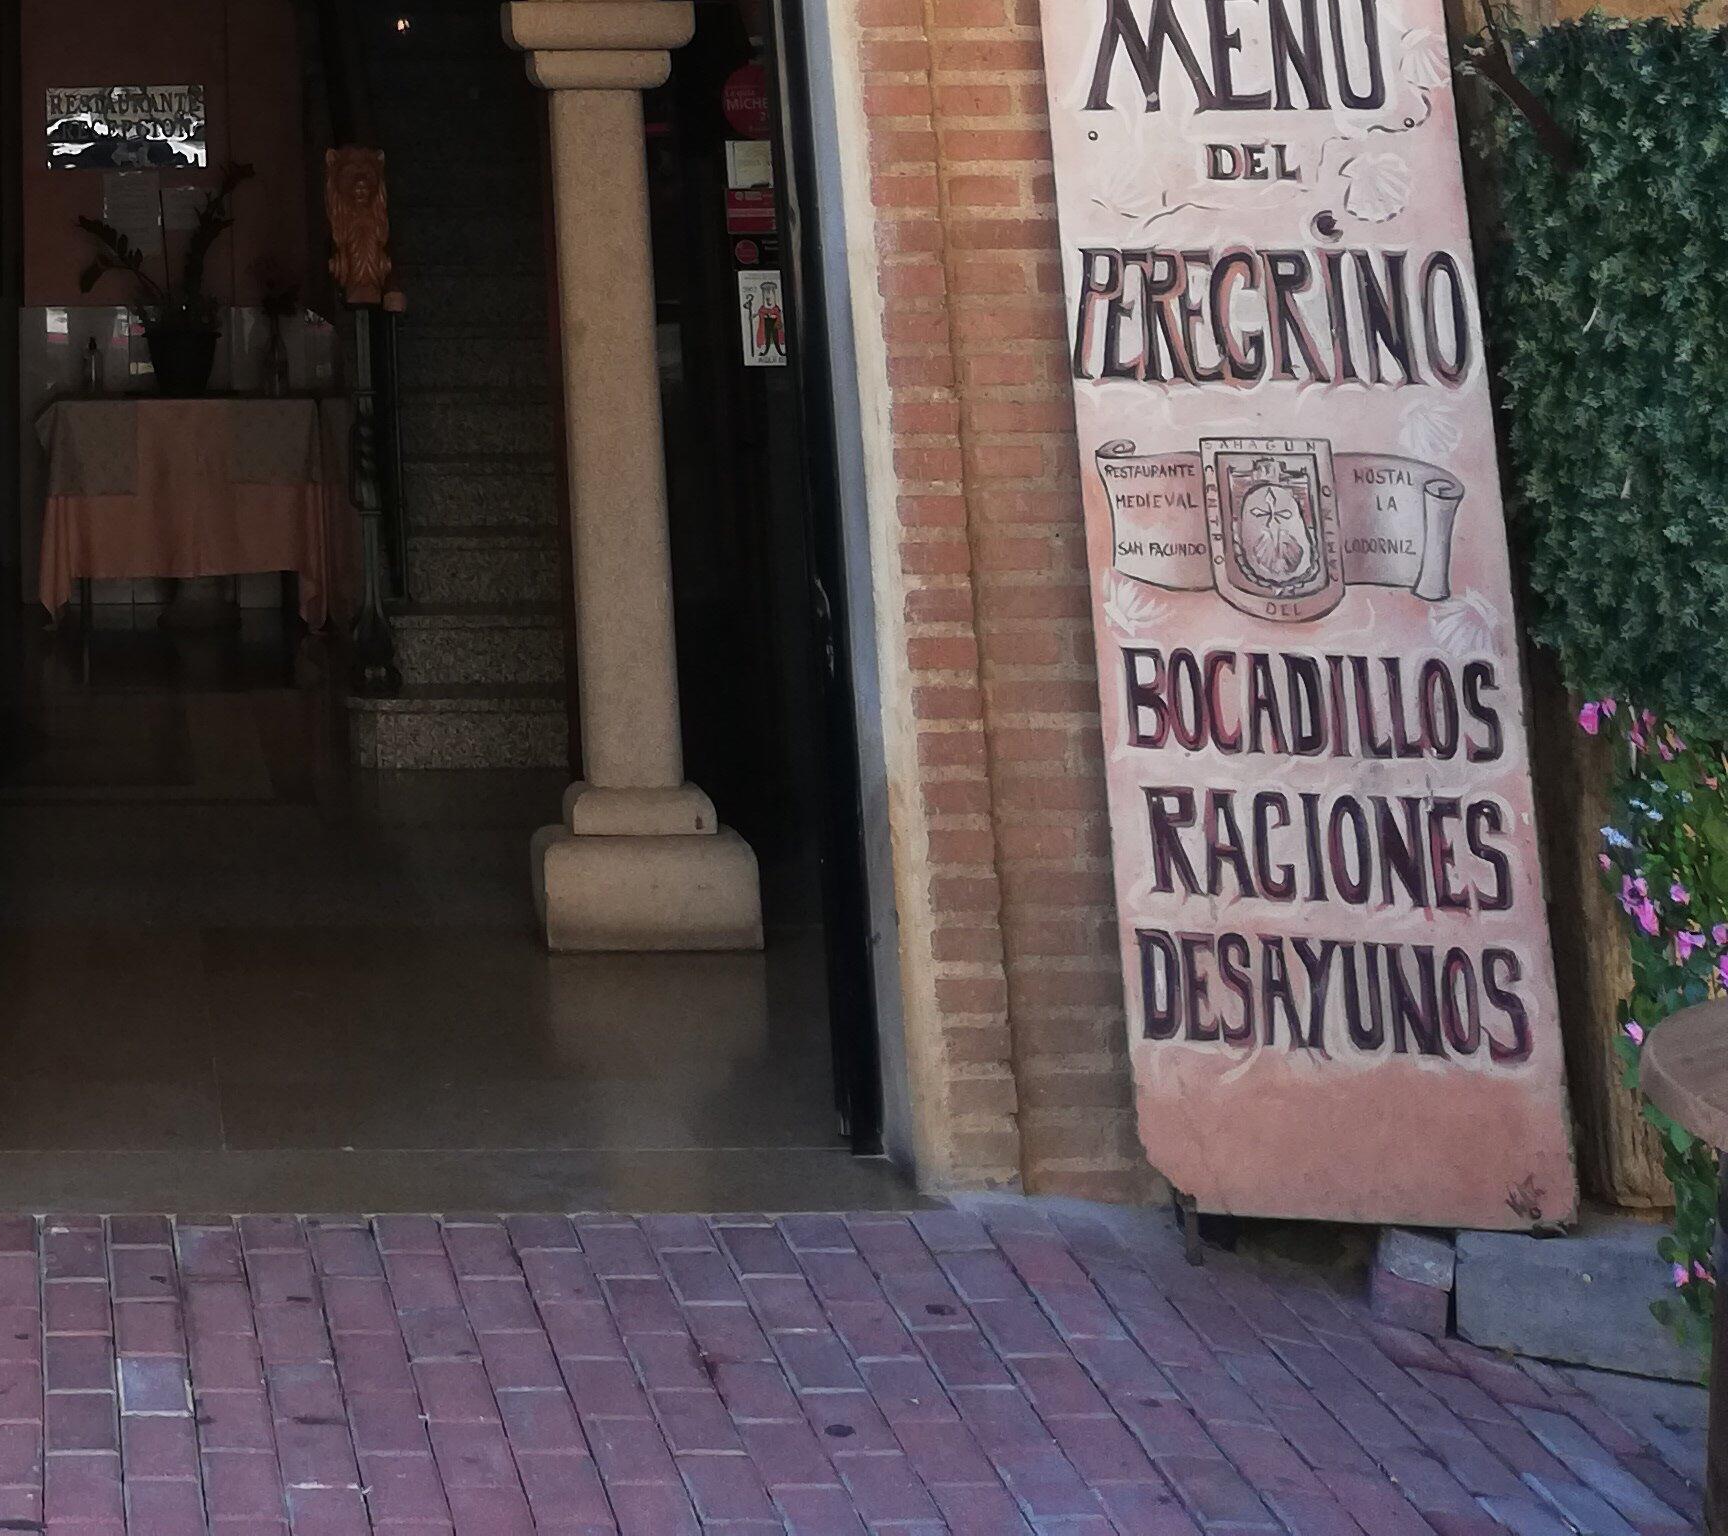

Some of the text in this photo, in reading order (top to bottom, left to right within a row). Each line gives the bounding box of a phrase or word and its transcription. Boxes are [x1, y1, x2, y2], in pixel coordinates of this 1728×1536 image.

[1205, 143, 1303, 181] DEL
[1072, 245, 1472, 389] PEREGRINO
[1104, 464, 1196, 479] RESTAURANTE
[1353, 469, 1413, 486] HOSTAL
[1115, 491, 1199, 510] MEDIEVAL
[1376, 495, 1398, 512] LA
[1149, 541, 1207, 558] FACUNDO
[1265, 602, 1301, 617] DEL
[1121, 646, 1504, 764] BOCADILLOS
[1140, 785, 1514, 911] RACIONES
[1135, 928, 1534, 1064] DESAYUNOS
